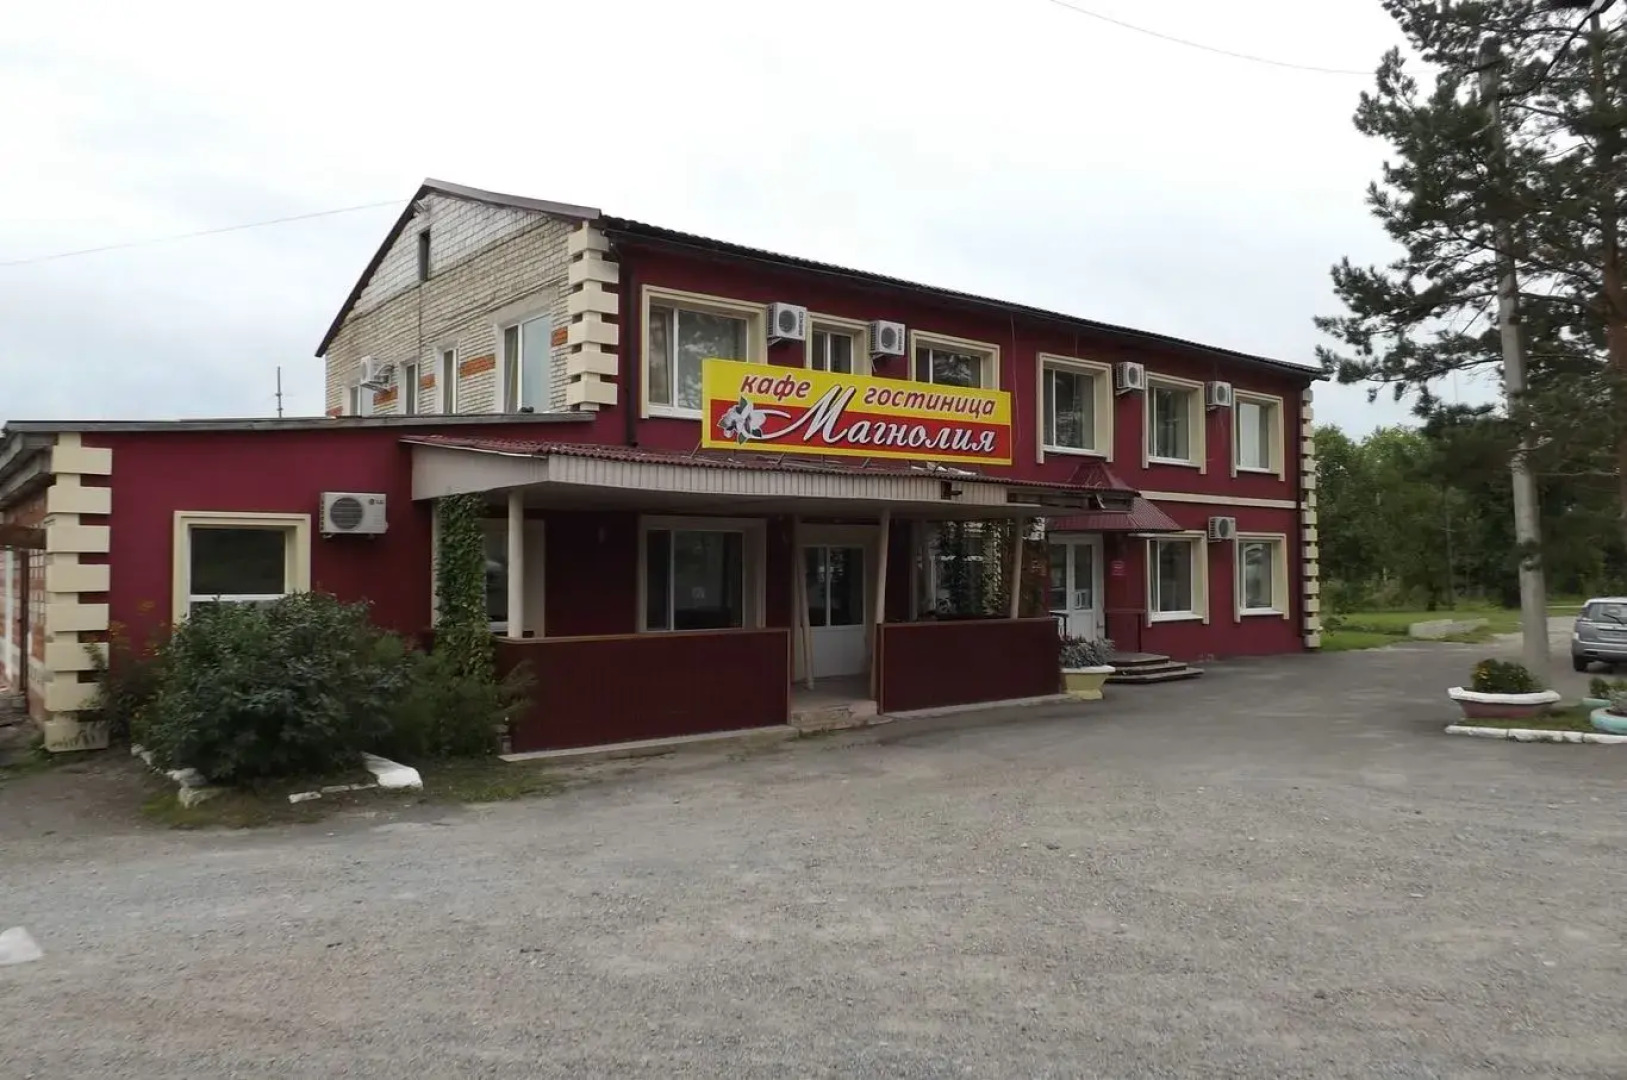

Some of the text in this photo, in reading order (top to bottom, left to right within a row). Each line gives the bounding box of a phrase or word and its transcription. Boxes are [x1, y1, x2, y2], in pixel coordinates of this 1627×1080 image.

[741, 374, 996, 419] кафе гостиница
[758, 384, 996, 452] Магнолия
